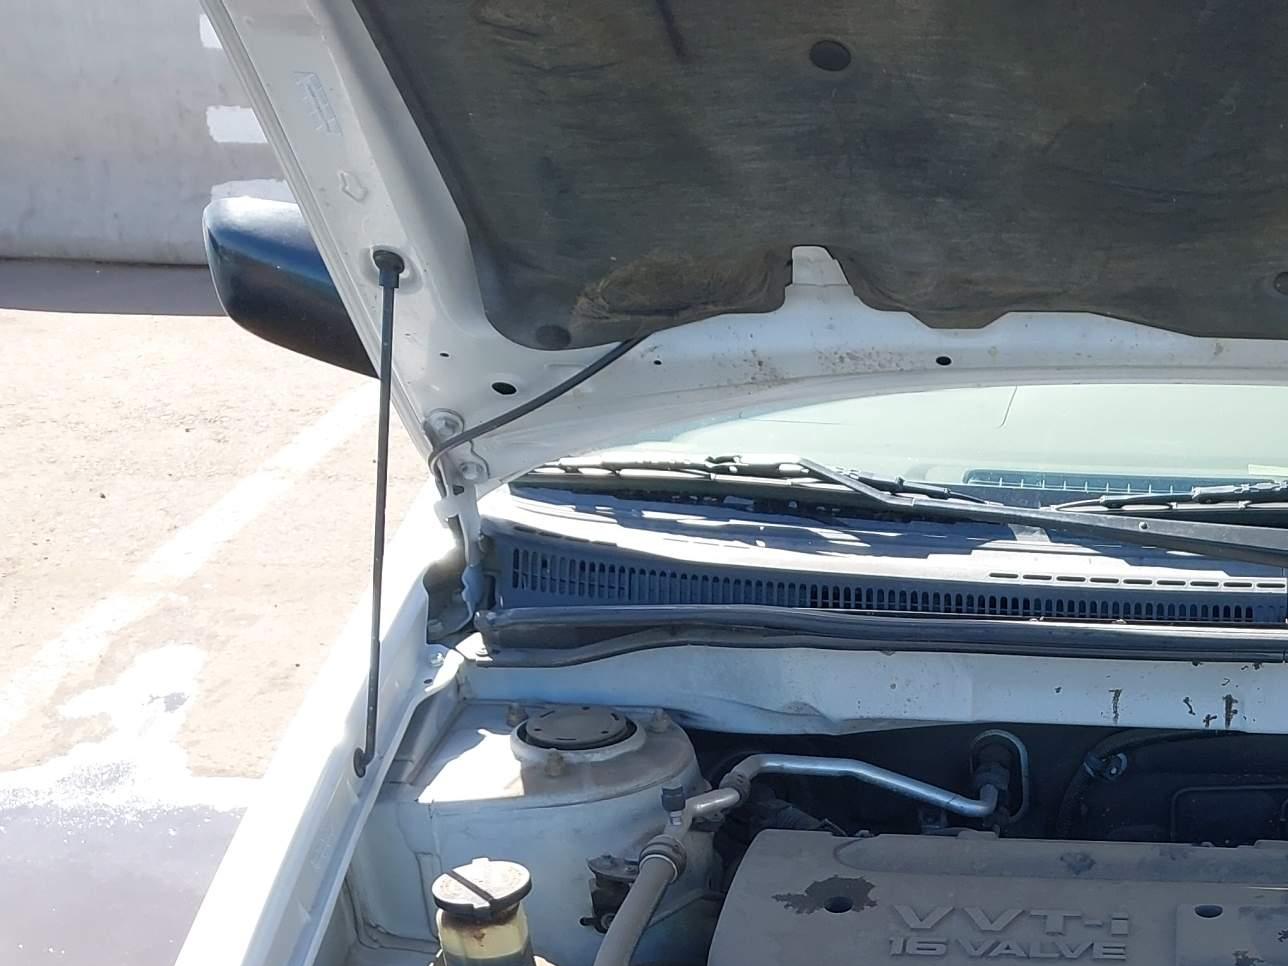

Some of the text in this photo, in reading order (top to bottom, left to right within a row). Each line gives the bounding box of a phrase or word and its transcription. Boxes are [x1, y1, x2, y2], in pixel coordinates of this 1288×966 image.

[893, 905, 1128, 935] VVT-i
[889, 936, 1128, 960] 16 VALVE
